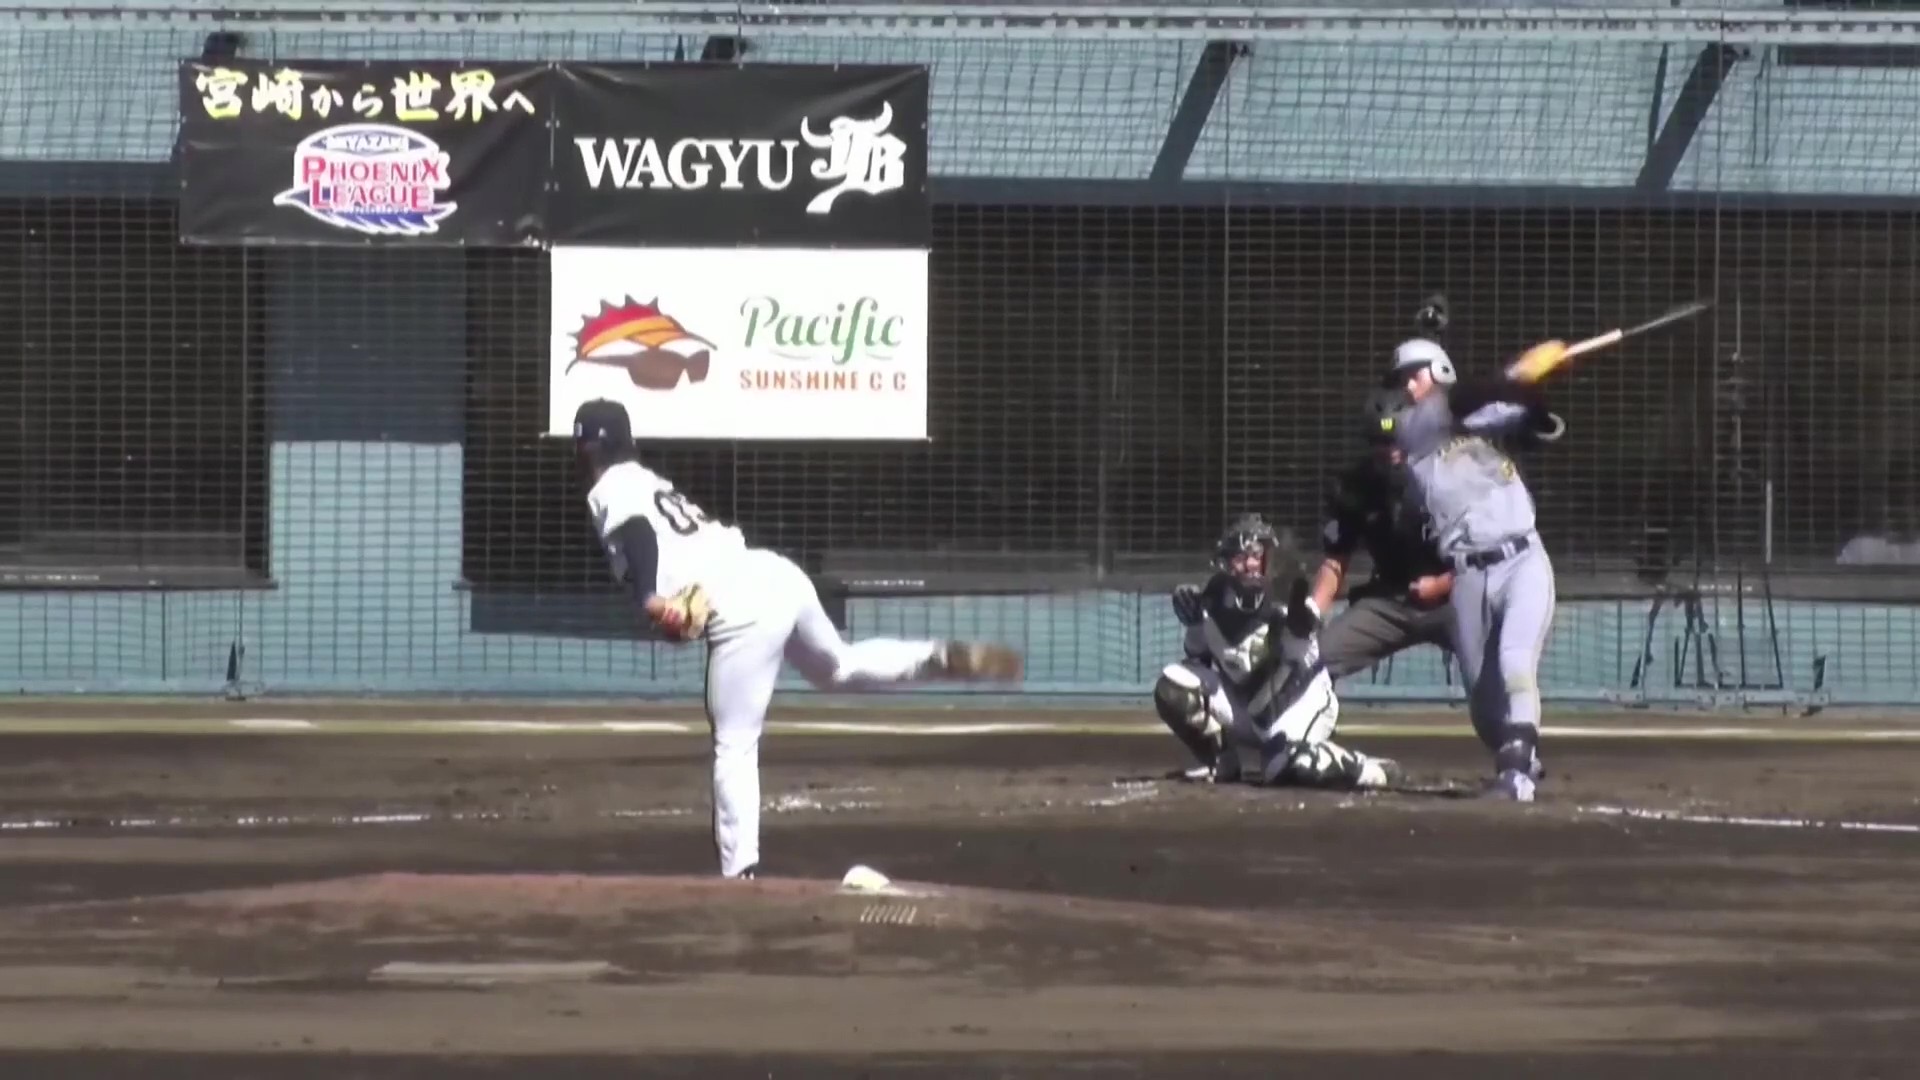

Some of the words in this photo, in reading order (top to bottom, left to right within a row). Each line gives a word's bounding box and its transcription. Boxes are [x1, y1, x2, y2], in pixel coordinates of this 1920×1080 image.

[195, 68, 535, 122] 宮崎から世界へ
[574, 137, 799, 190] WAGYU
[740, 296, 904, 365] Pacific
[740, 369, 859, 391] SUNSHINE
